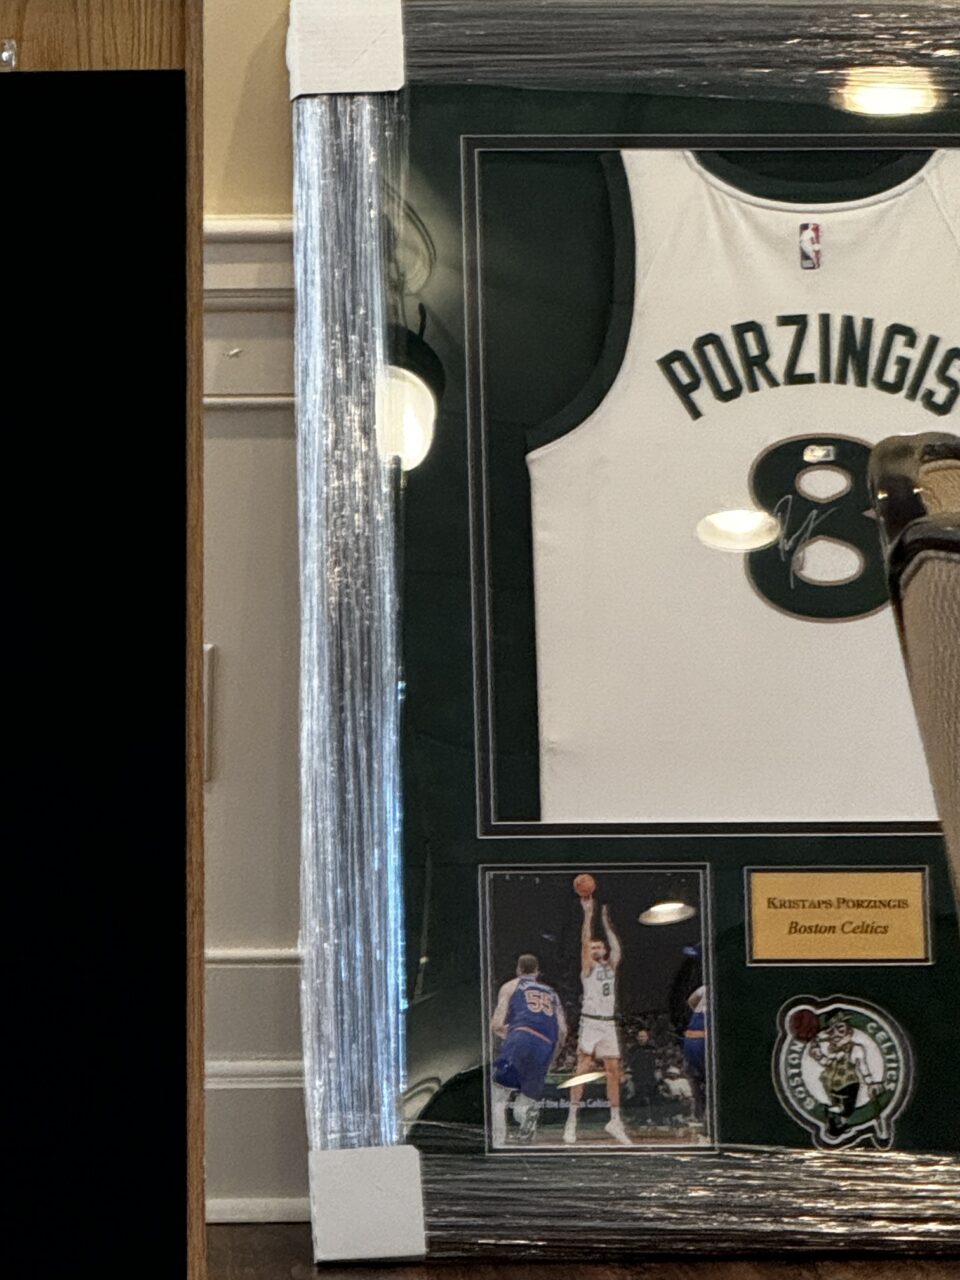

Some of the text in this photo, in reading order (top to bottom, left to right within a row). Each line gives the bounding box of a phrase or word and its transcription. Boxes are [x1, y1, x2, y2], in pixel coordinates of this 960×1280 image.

[656, 313, 960, 421] PORZINGIS
[744, 433, 892, 623] 8
[767, 897, 909, 910] KRISTAPS PORZINGIS
[788, 921, 889, 935] Boston Celtics
